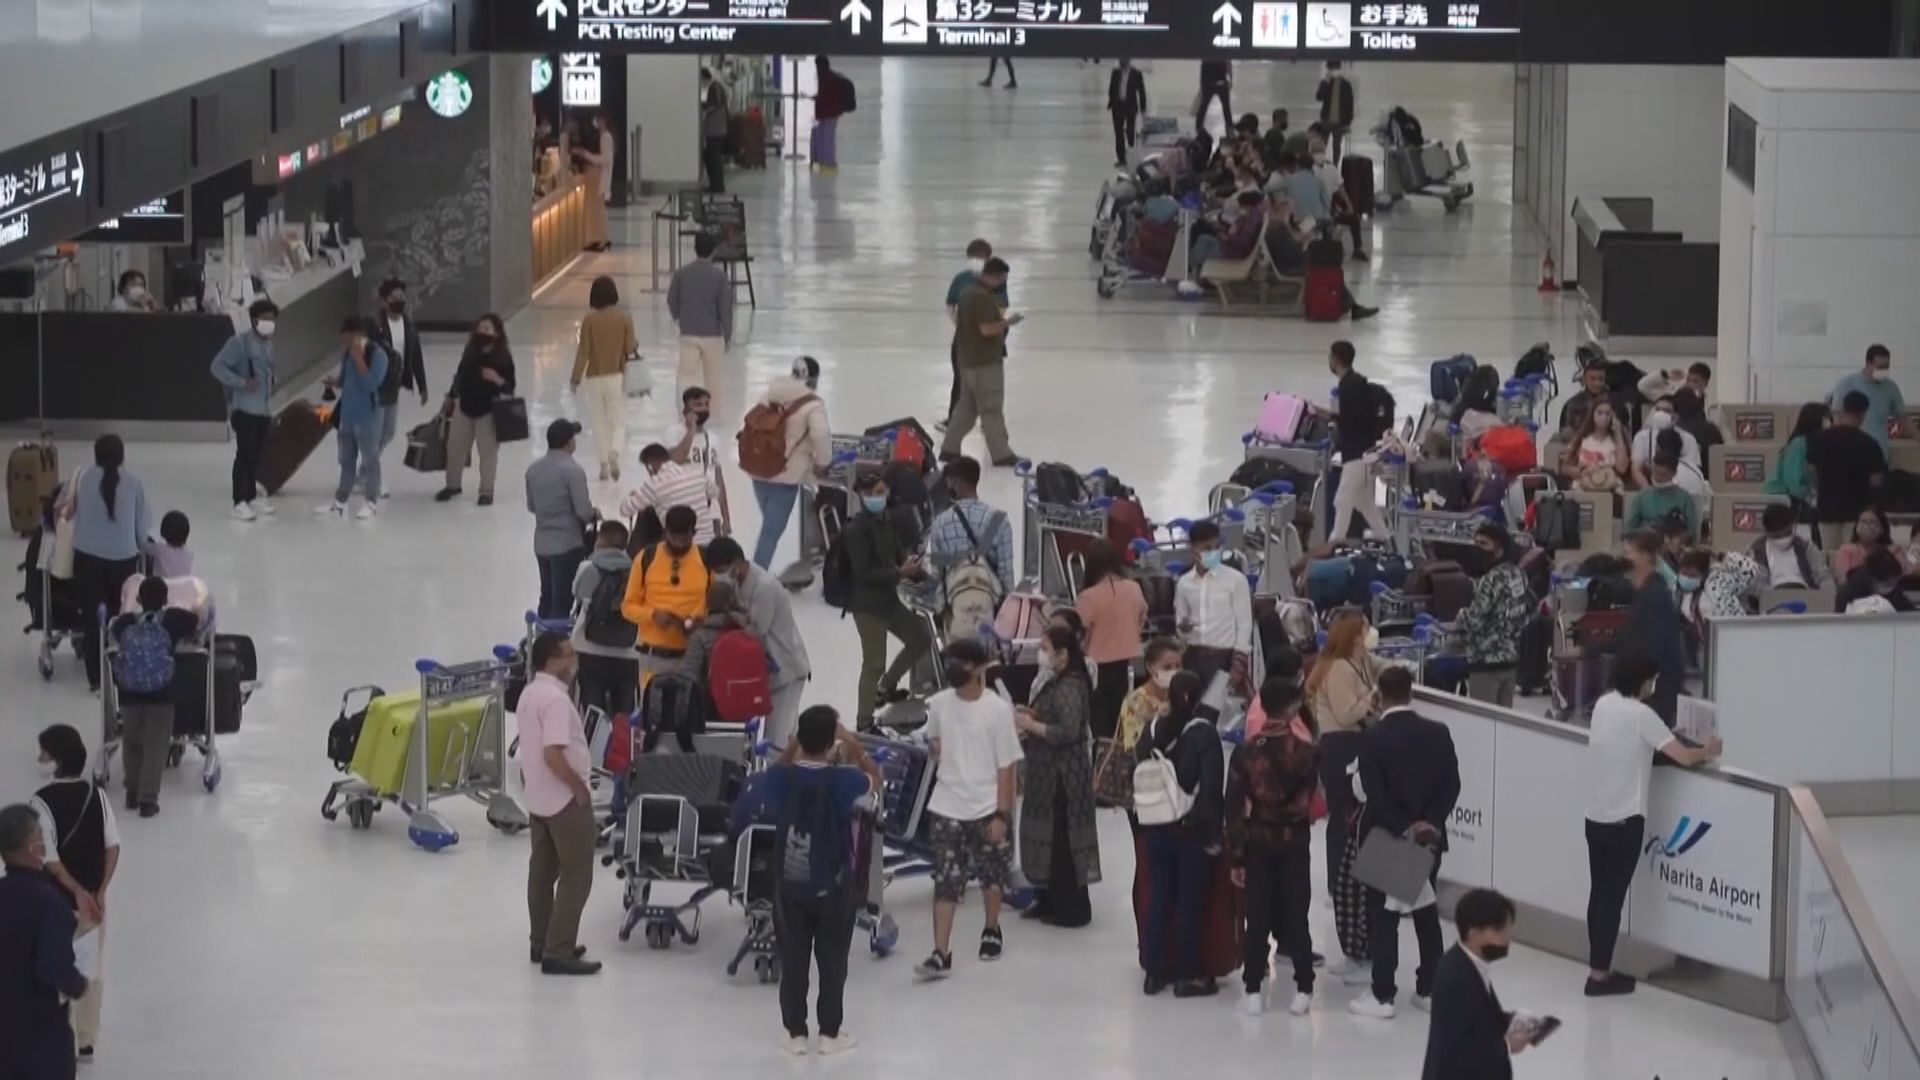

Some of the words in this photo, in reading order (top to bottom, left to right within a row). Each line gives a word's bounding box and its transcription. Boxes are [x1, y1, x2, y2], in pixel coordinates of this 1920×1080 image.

[1360, 4, 1428, 26] お手洗
[578, 24, 611, 39] PCR
[614, 24, 675, 43] Testing
[678, 24, 736, 40] Center
[936, 28, 1010, 45] Terminal
[1014, 28, 1026, 45] 3
[1360, 32, 1416, 50] Toilets
[1660, 861, 1704, 892] Narita
[1709, 876, 1760, 910] Airport
